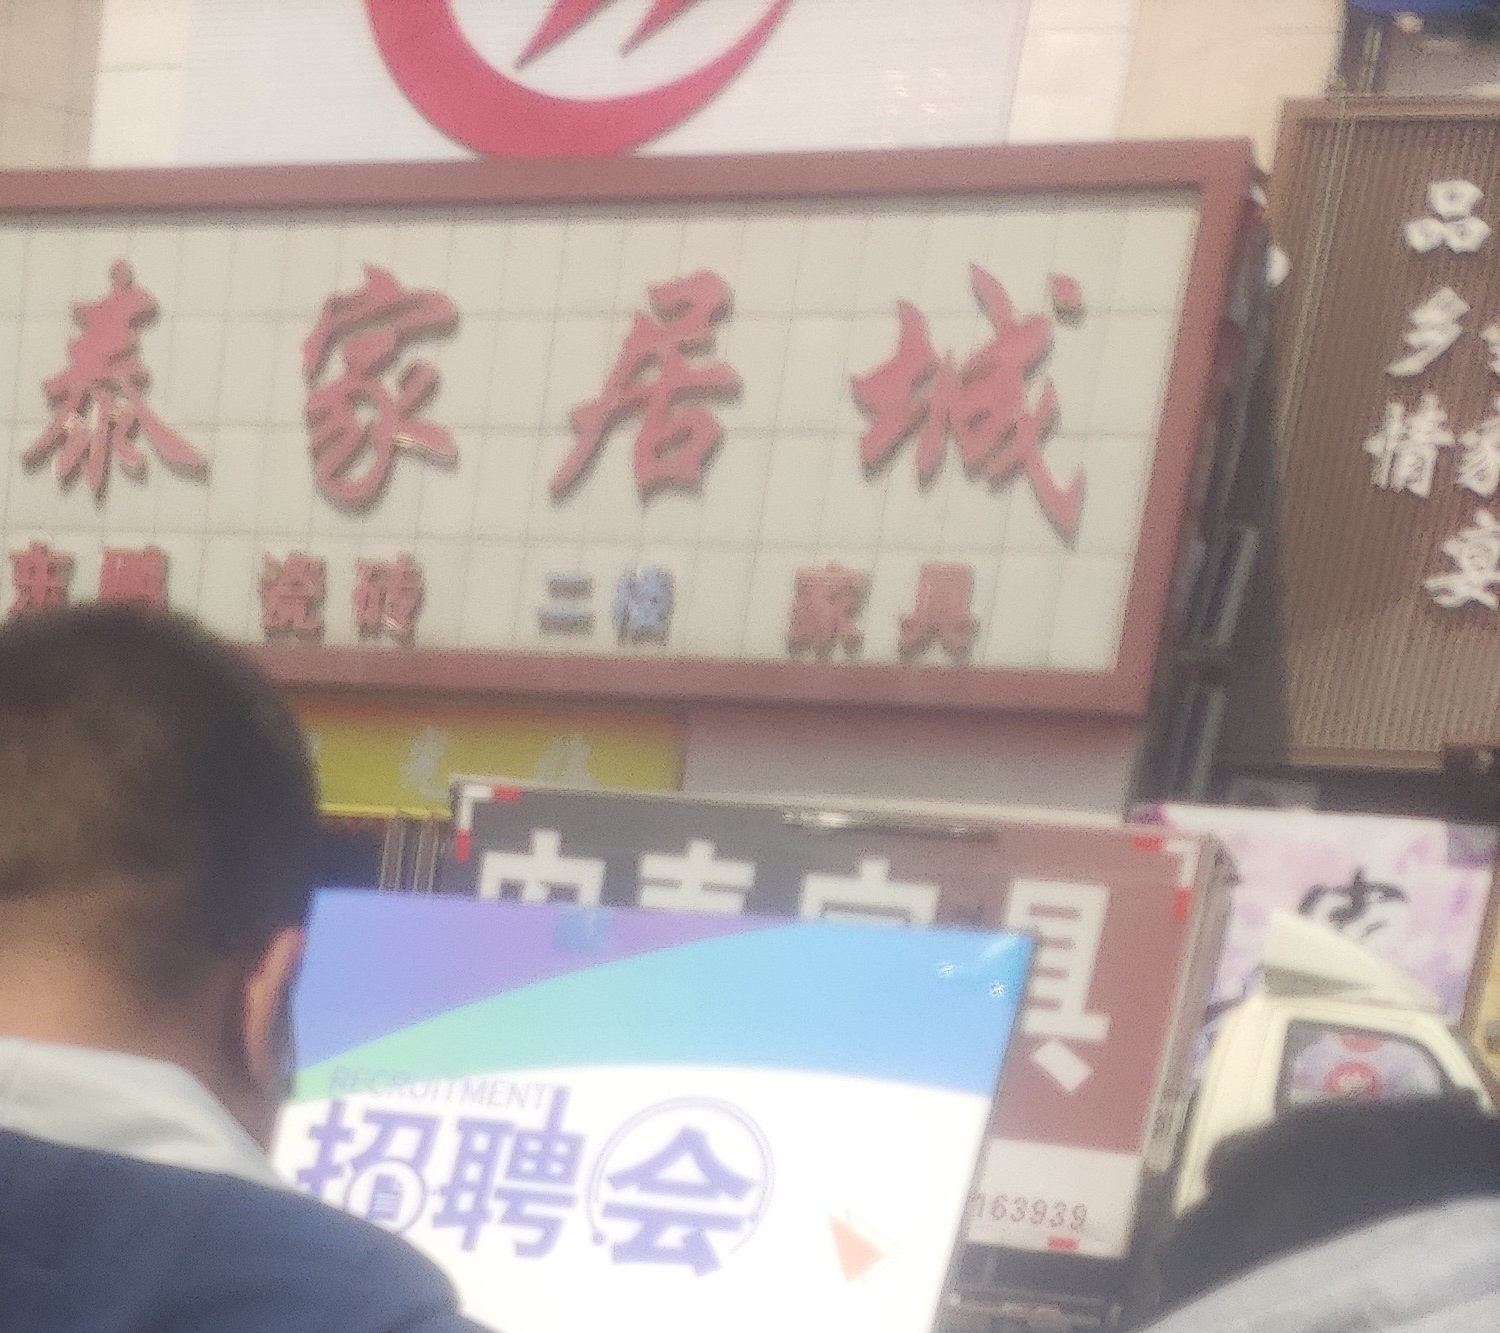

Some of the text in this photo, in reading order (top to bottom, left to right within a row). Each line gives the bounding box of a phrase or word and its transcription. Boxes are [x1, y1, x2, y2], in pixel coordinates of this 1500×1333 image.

[329, 1064, 548, 1110] RECRUITMENT
[297, 1083, 758, 1278] 招聘会
